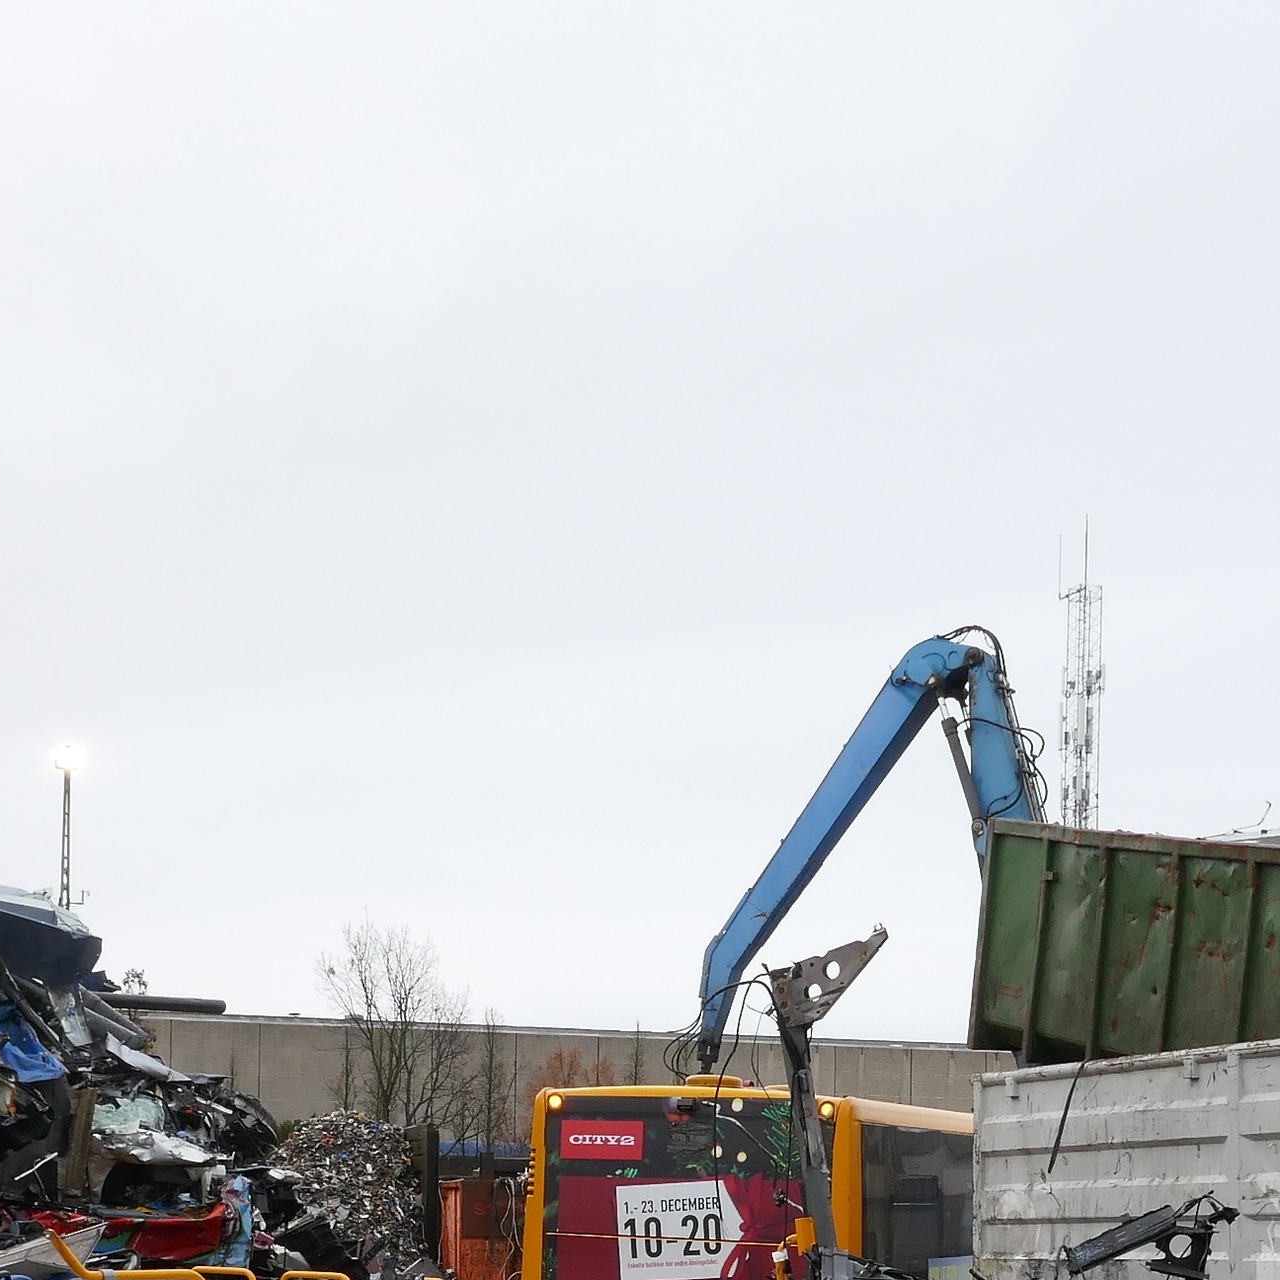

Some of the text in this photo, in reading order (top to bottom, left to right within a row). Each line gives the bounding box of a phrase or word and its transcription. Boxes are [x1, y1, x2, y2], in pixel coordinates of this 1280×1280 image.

[569, 1134, 635, 1146] CITY2
[641, 1200, 657, 1213] 23.
[660, 1197, 720, 1212] DECEMBER
